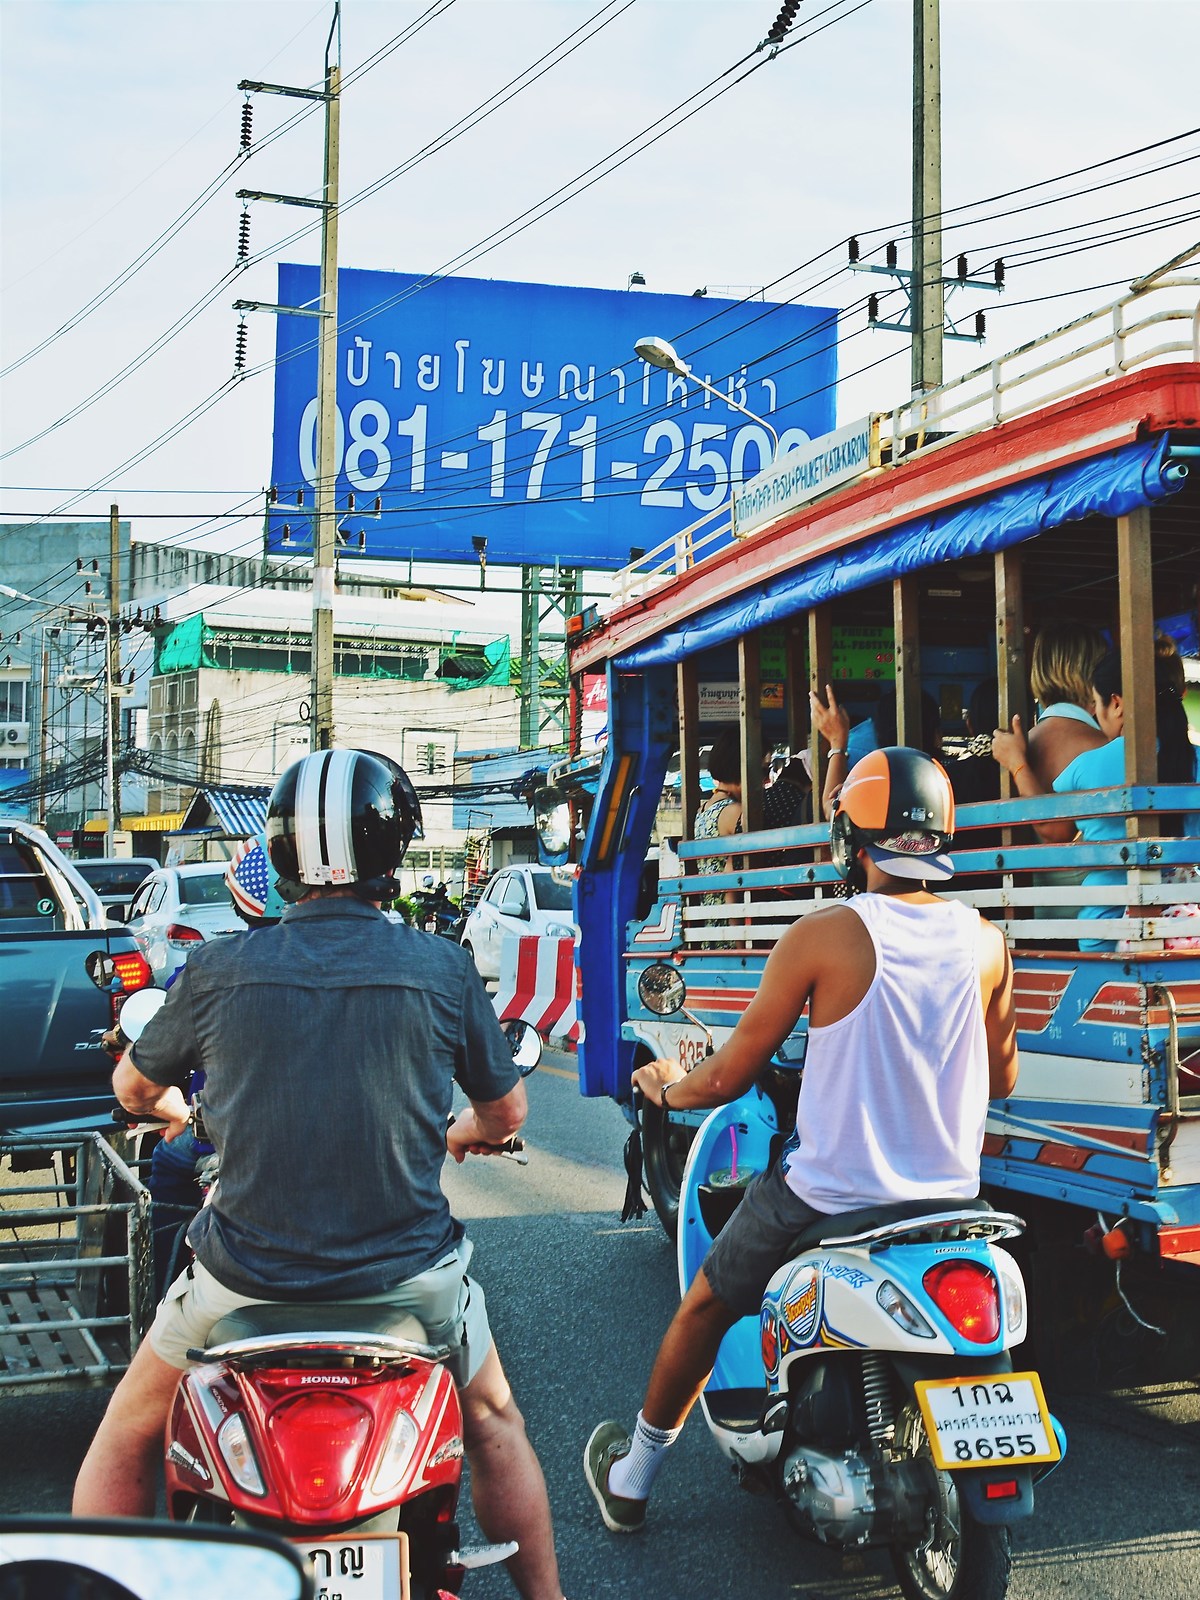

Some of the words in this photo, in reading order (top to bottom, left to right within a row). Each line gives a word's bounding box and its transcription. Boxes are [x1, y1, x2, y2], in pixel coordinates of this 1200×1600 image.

[346, 335, 778, 415] ป้ายโฆษณาใหเช่า
[300, 1375, 351, 1386] HONDA
[953, 1434, 1037, 1461] 8655
